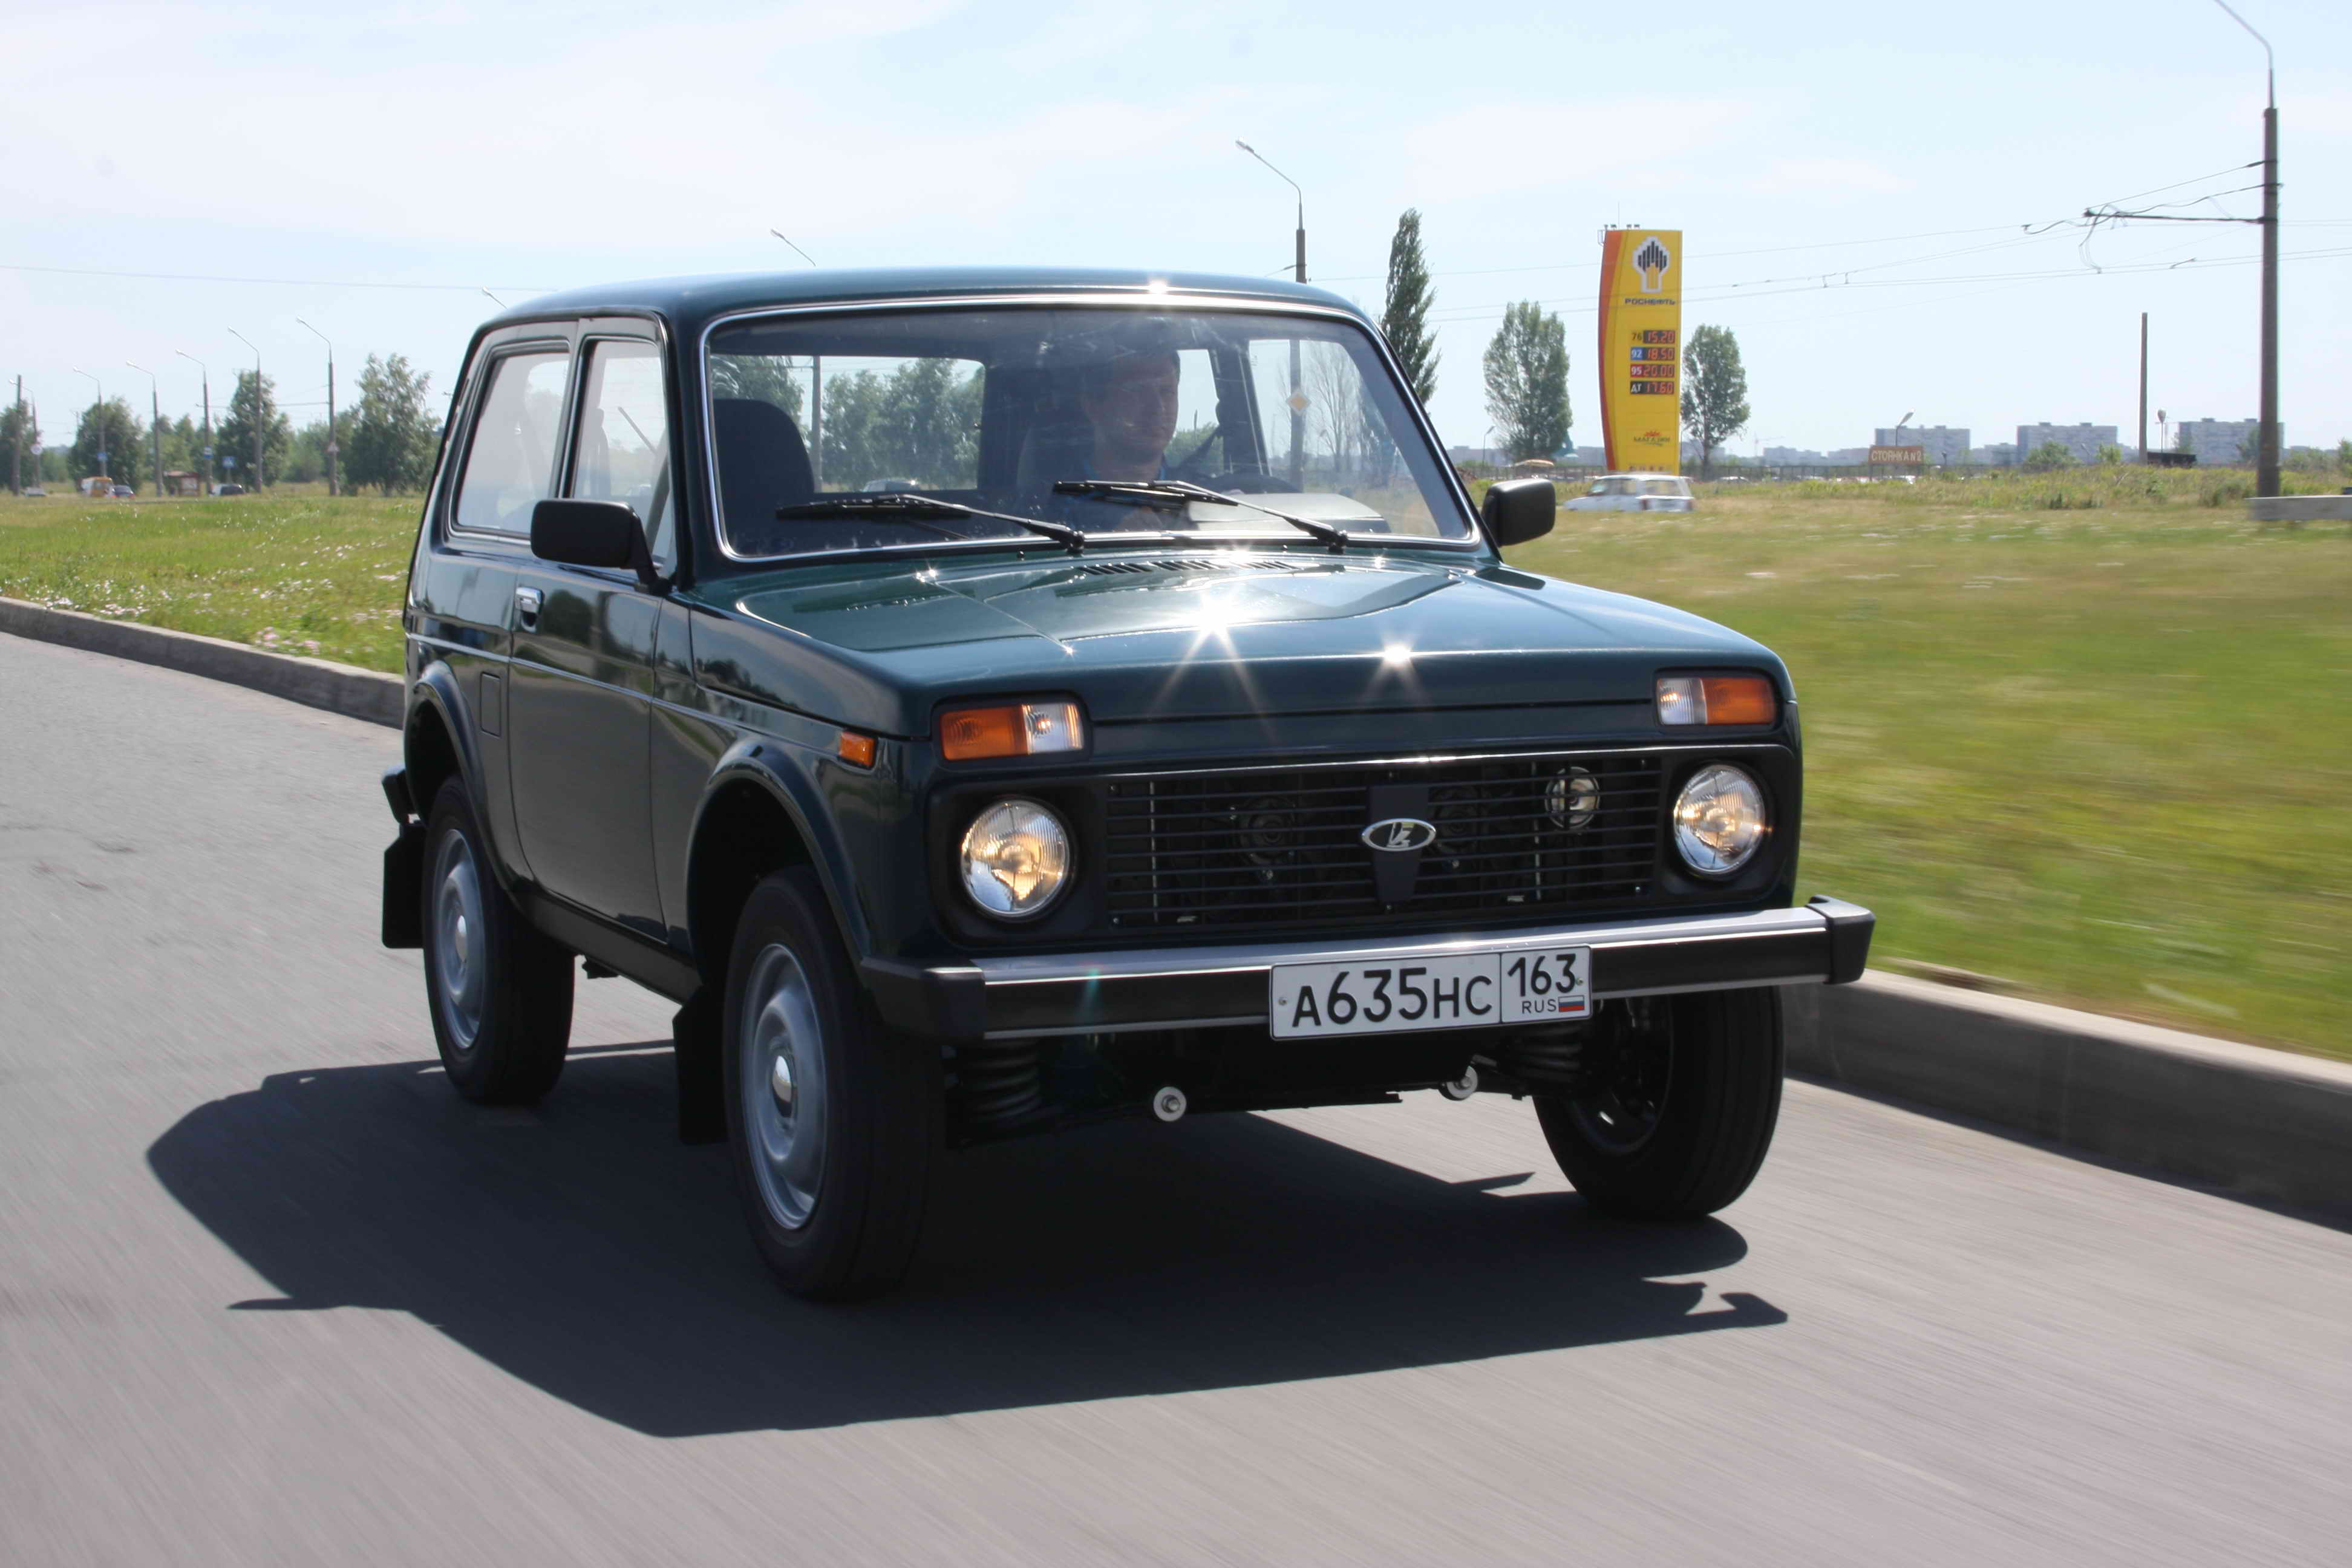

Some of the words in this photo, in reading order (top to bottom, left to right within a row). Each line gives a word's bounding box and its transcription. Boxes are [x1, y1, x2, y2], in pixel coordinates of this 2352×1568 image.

[1632, 332, 1642, 341] 76
[1631, 349, 1642, 358] 92
[1631, 365, 1642, 375] 95
[1508, 953, 1576, 997] 163
[1521, 999, 1557, 1014] RUS
